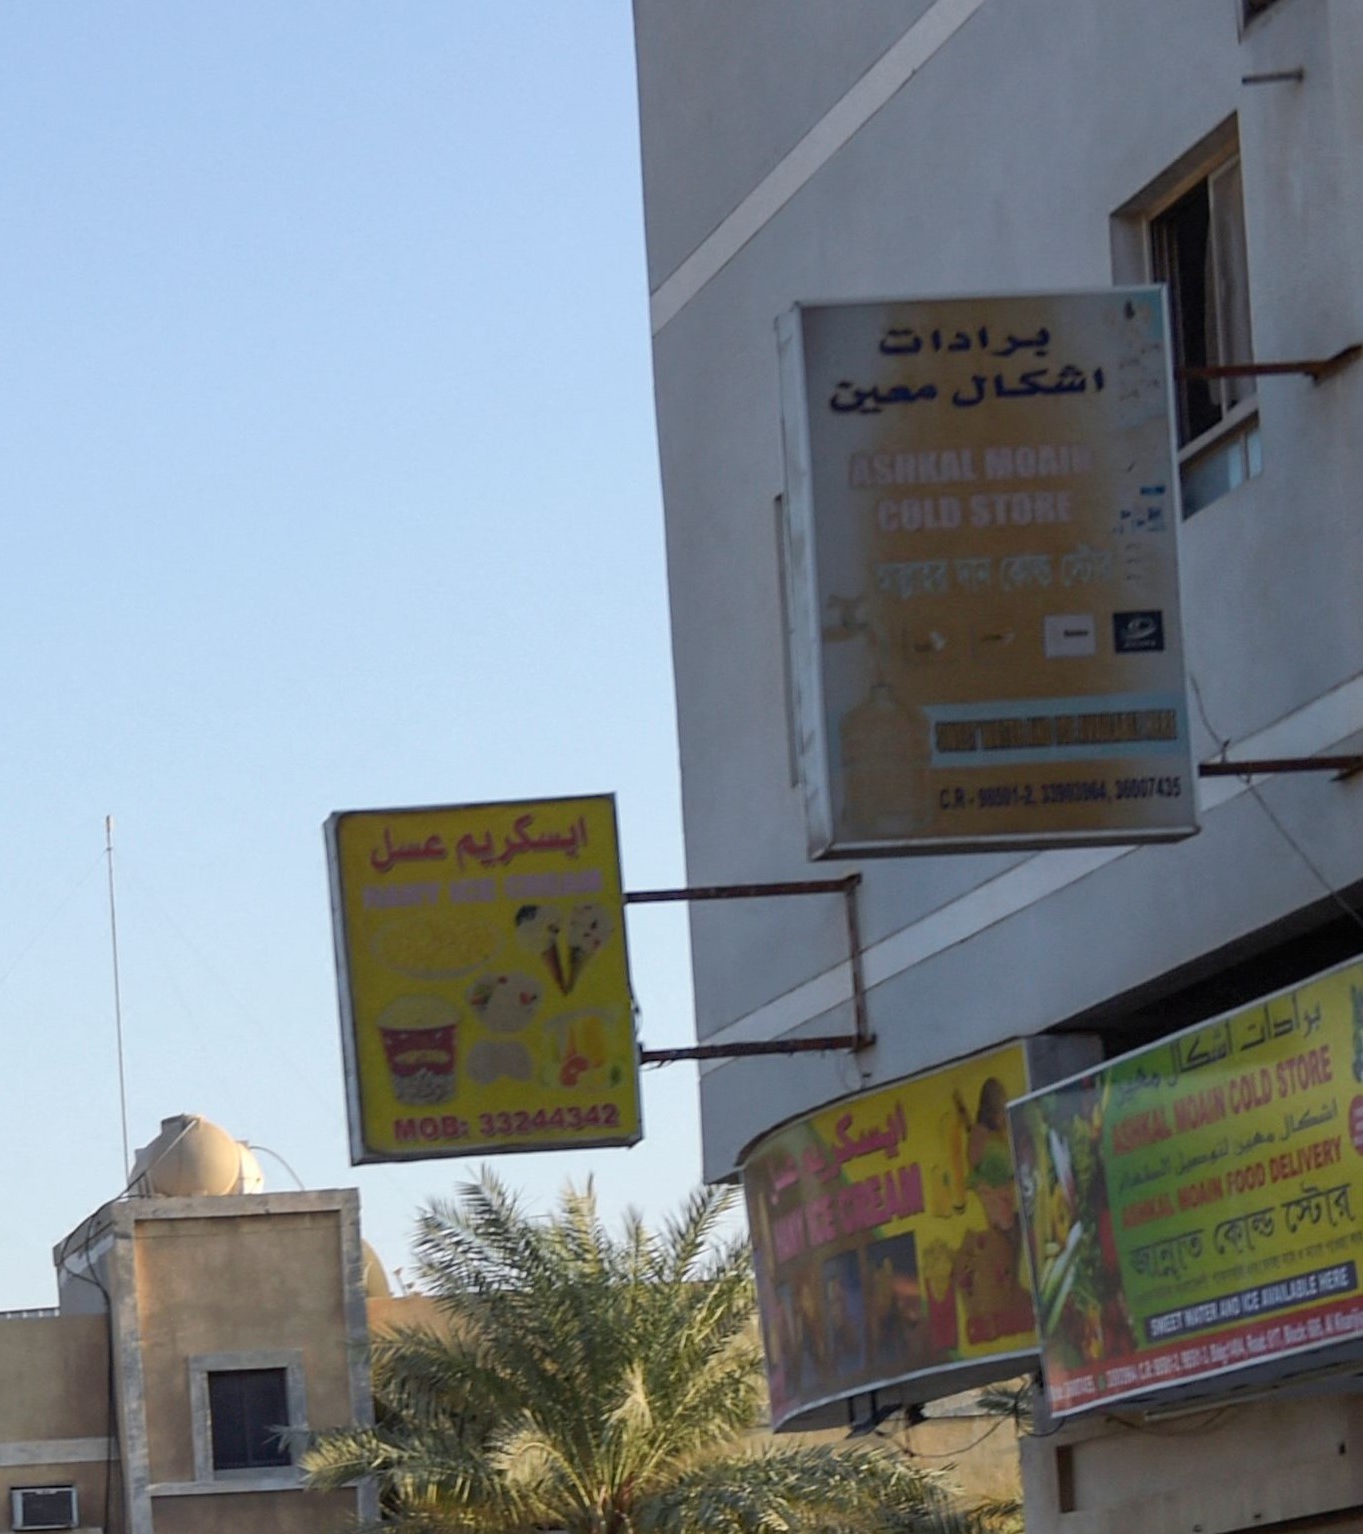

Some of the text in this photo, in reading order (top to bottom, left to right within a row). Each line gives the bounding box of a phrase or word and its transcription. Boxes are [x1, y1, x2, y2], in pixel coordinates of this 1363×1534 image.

[878, 326, 1050, 357] برادات
[829, 381, 938, 413] معين
[877, 496, 962, 531] COLD
[970, 491, 1071, 527] STORE
[370, 827, 450, 872] عسل
[1240, 992, 1321, 1053] برادات
[1228, 1067, 1273, 1115] COLD
[1276, 1044, 1333, 1099] STORE
[394, 1103, 620, 1142] MOB: 33244342
[1227, 1161, 1266, 1196] FOOD
[1269, 1136, 1342, 1185] DELIVERY
[1319, 1266, 1350, 1293] HERE
